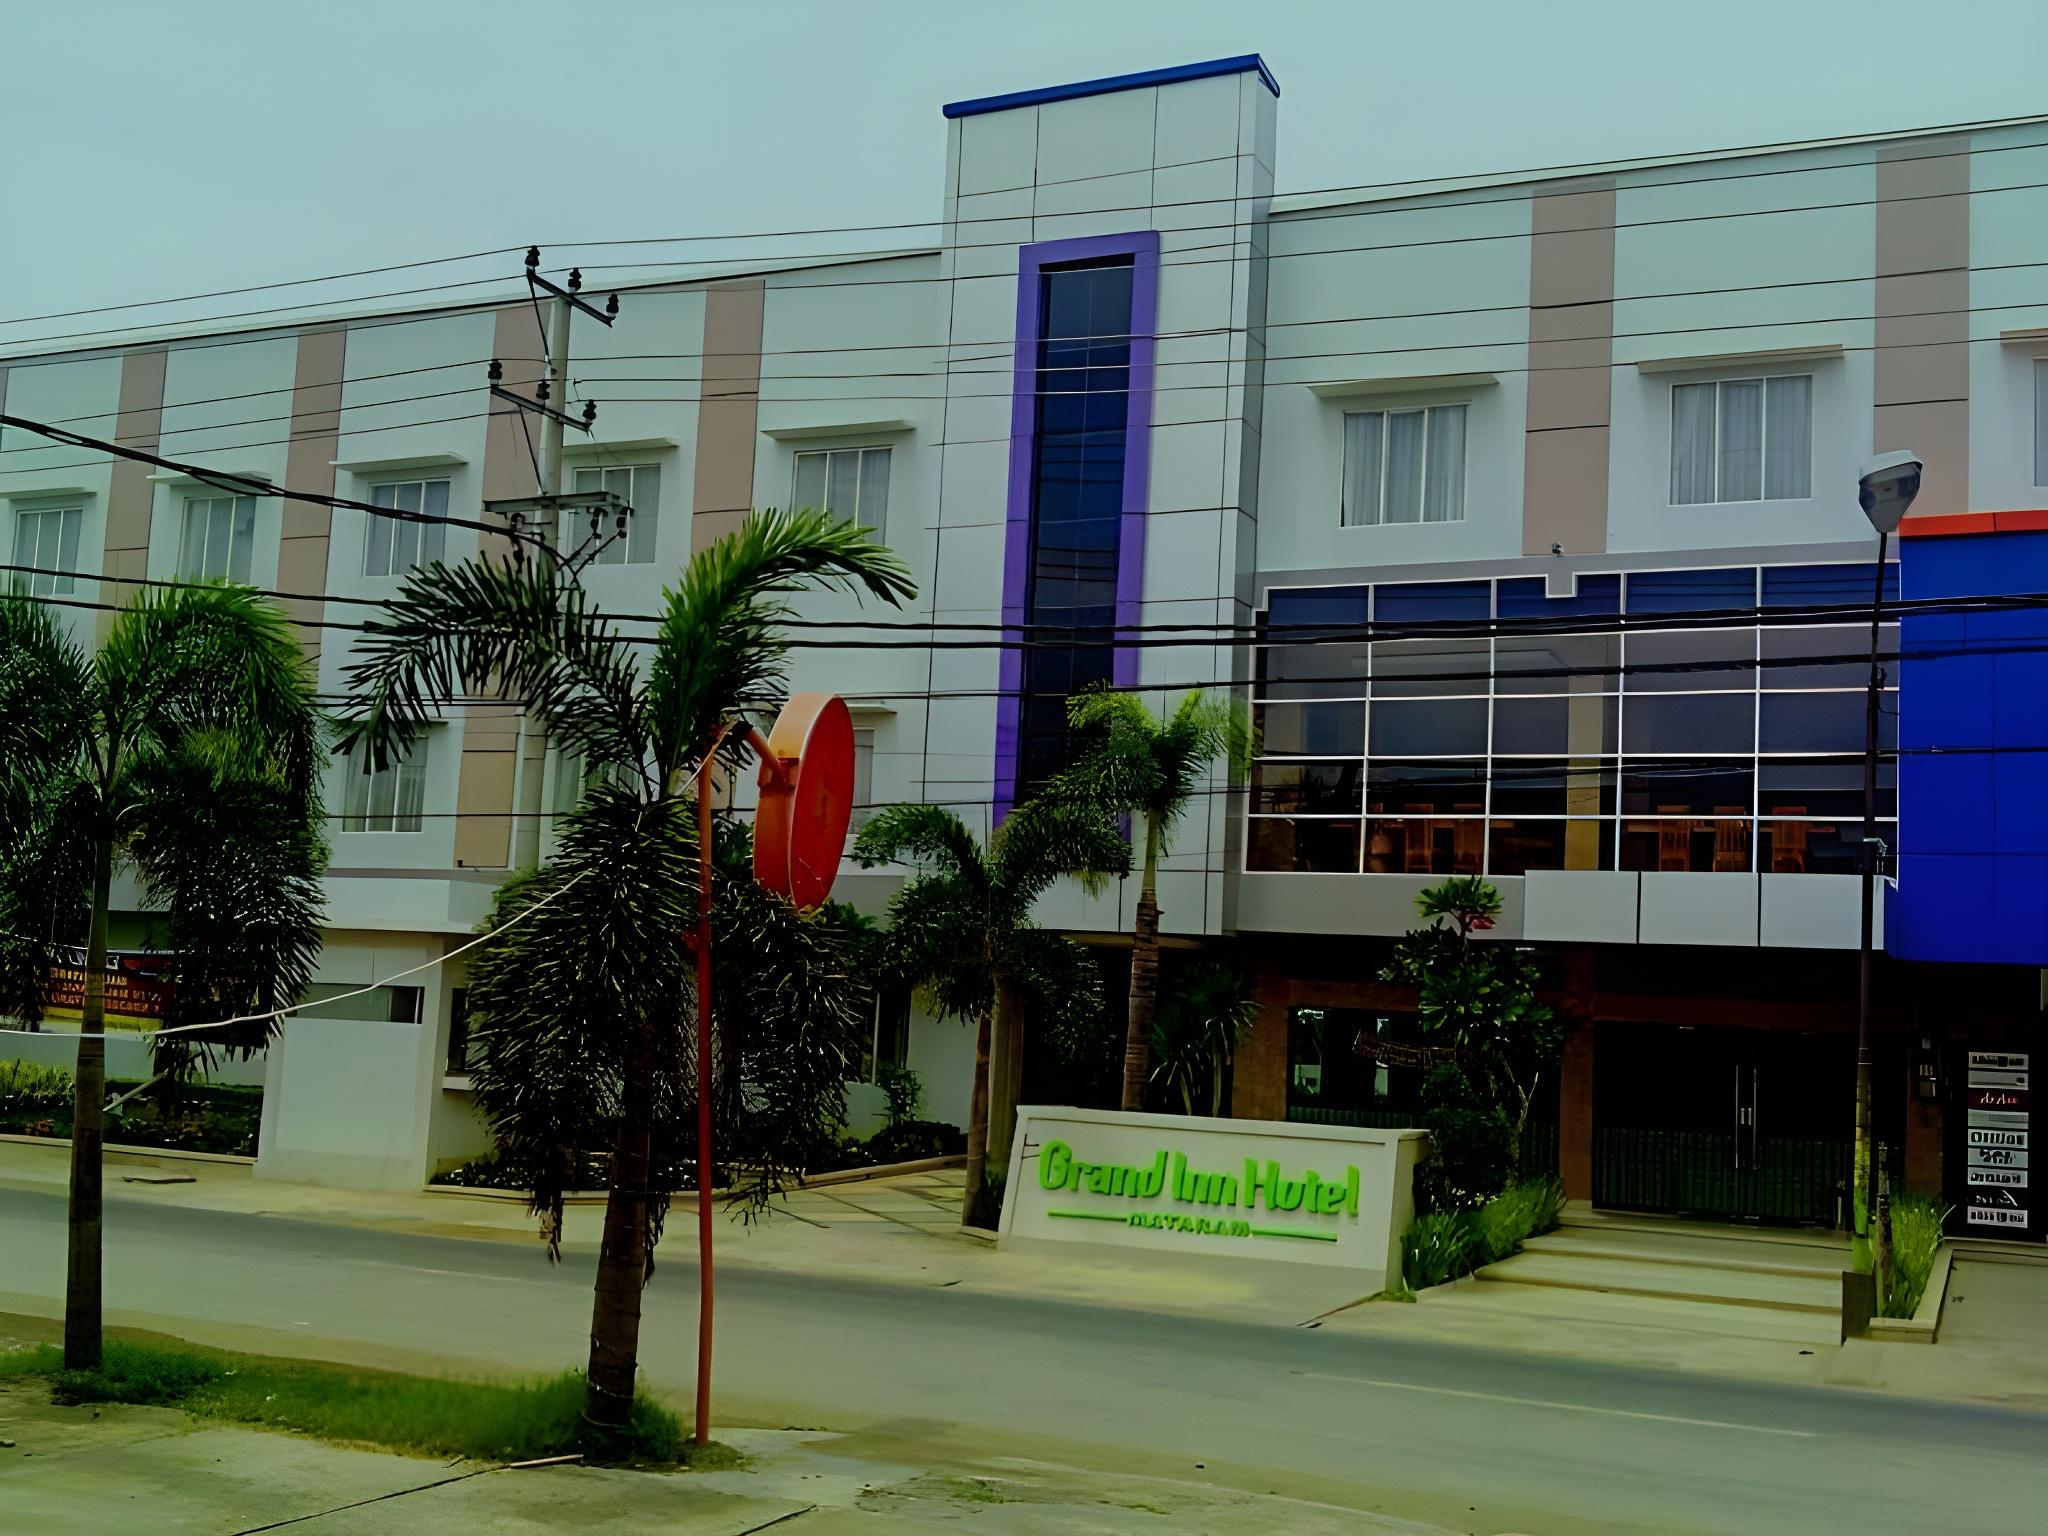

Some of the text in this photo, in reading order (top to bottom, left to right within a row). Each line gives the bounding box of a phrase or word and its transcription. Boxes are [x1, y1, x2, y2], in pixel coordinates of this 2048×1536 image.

[1038, 1138, 1361, 1218] Grand Inn Hotel
